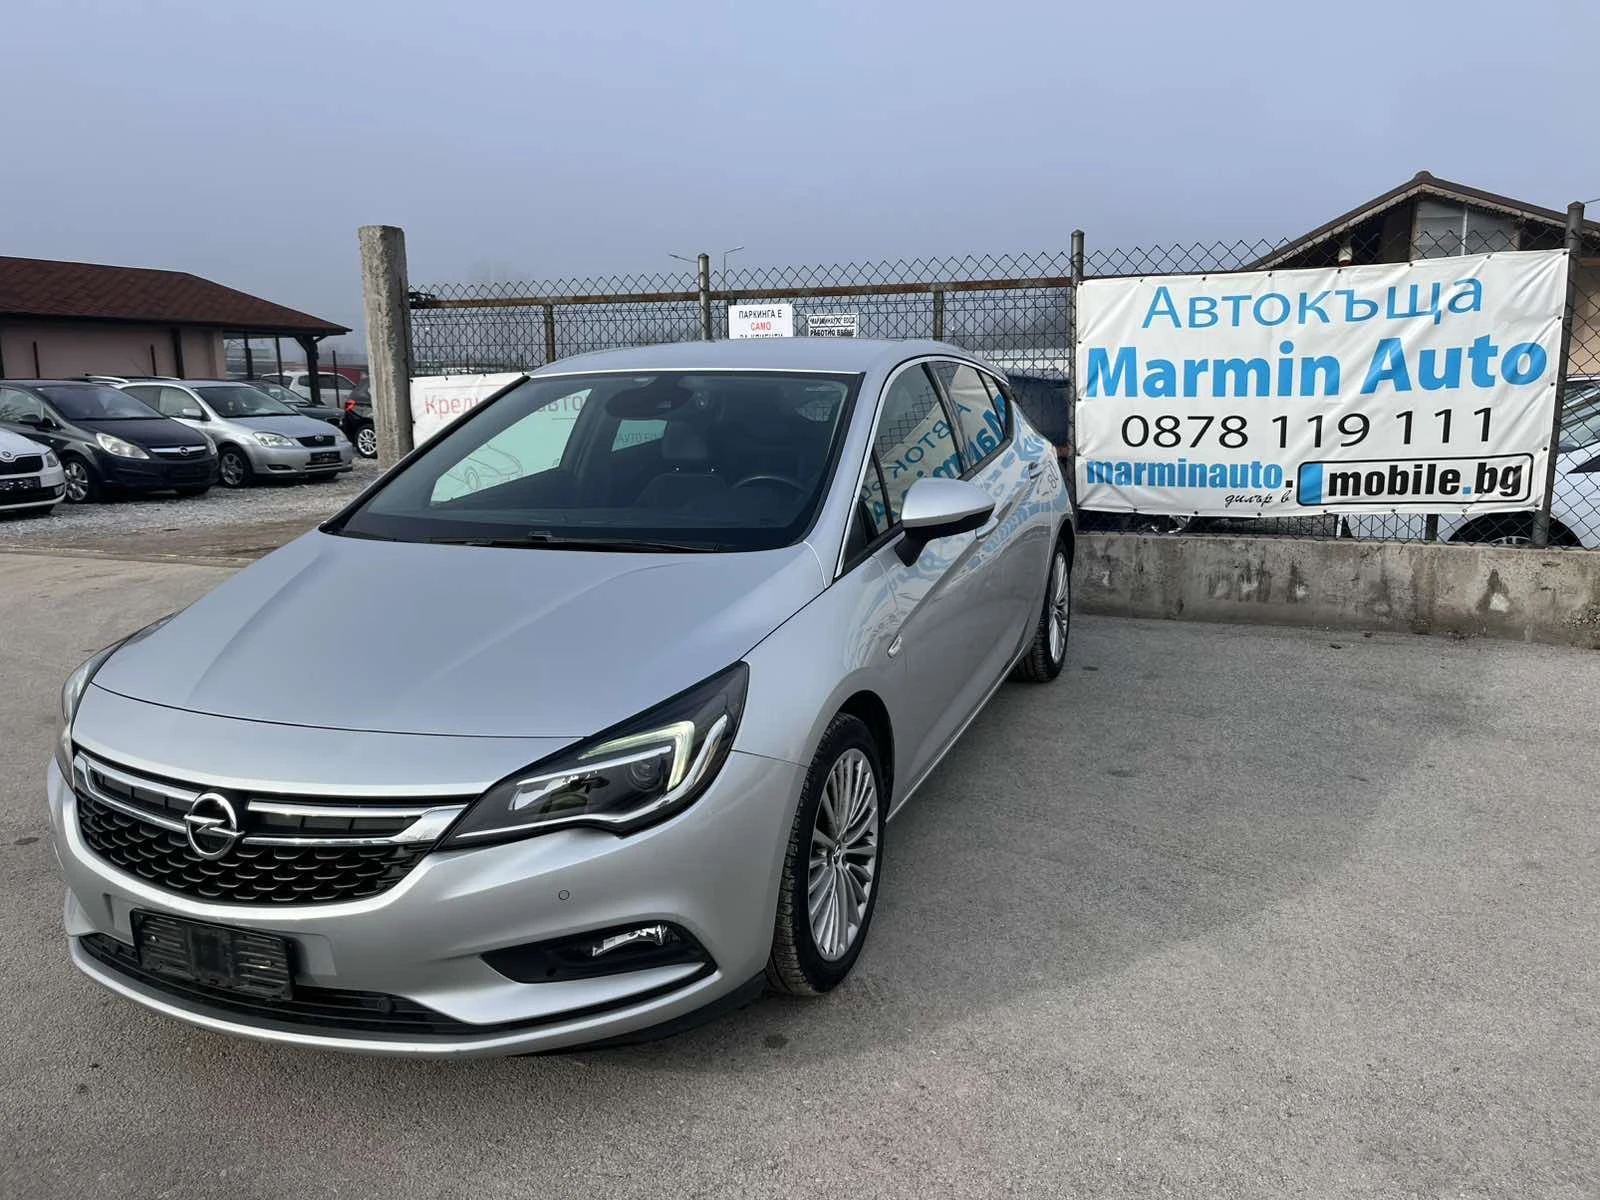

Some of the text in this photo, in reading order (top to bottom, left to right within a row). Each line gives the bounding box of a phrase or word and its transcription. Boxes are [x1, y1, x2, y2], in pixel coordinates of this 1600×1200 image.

[738, 310, 776, 319] ПАРКИНГА
[1142, 278, 1482, 328] Автокъща
[751, 321, 771, 330] САМО
[1086, 334, 1548, 397] Marmin Auto
[1121, 407, 1494, 449] 0878 119 111
[1328, 462, 1523, 497] mobile.bg
